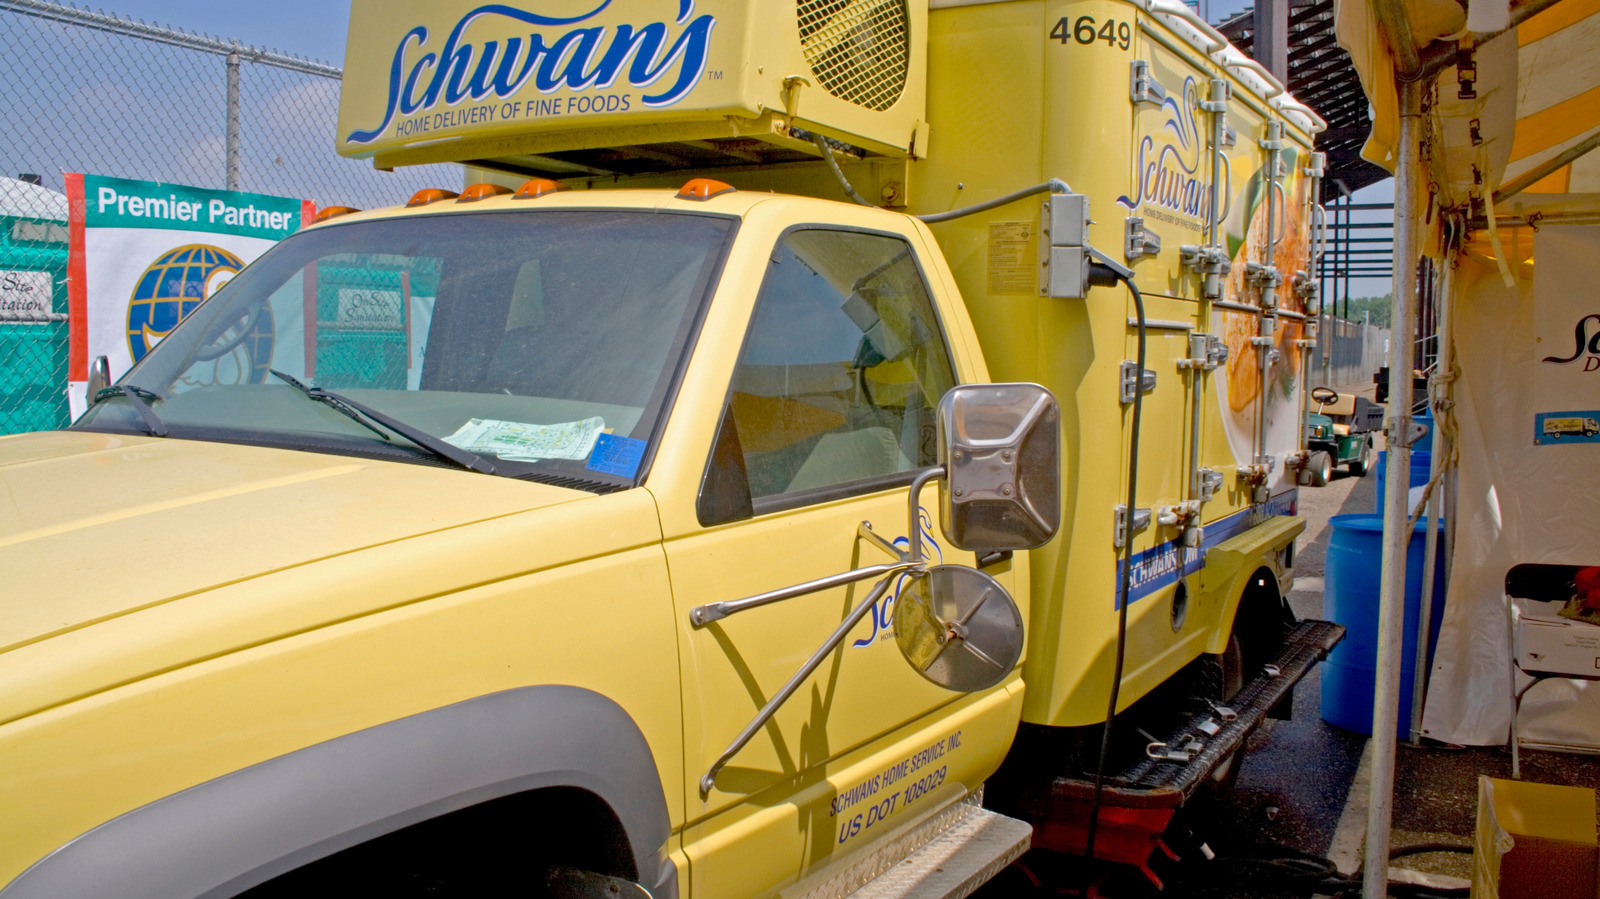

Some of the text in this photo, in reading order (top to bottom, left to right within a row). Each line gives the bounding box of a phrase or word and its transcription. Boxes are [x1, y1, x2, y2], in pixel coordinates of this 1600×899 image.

[1050, 15, 1130, 51] 4649
[346, 0, 716, 143] Schwan's
[396, 94, 631, 137] HOME DELIVERY OF FINE FOODS
[98, 187, 292, 230] Premier Partner
[2, 272, 33, 294] Site
[830, 774, 880, 817] SCHWANS
[881, 759, 910, 789] HOME
[910, 739, 946, 773] SERVICE
[838, 765, 947, 844] US DOT 108029
